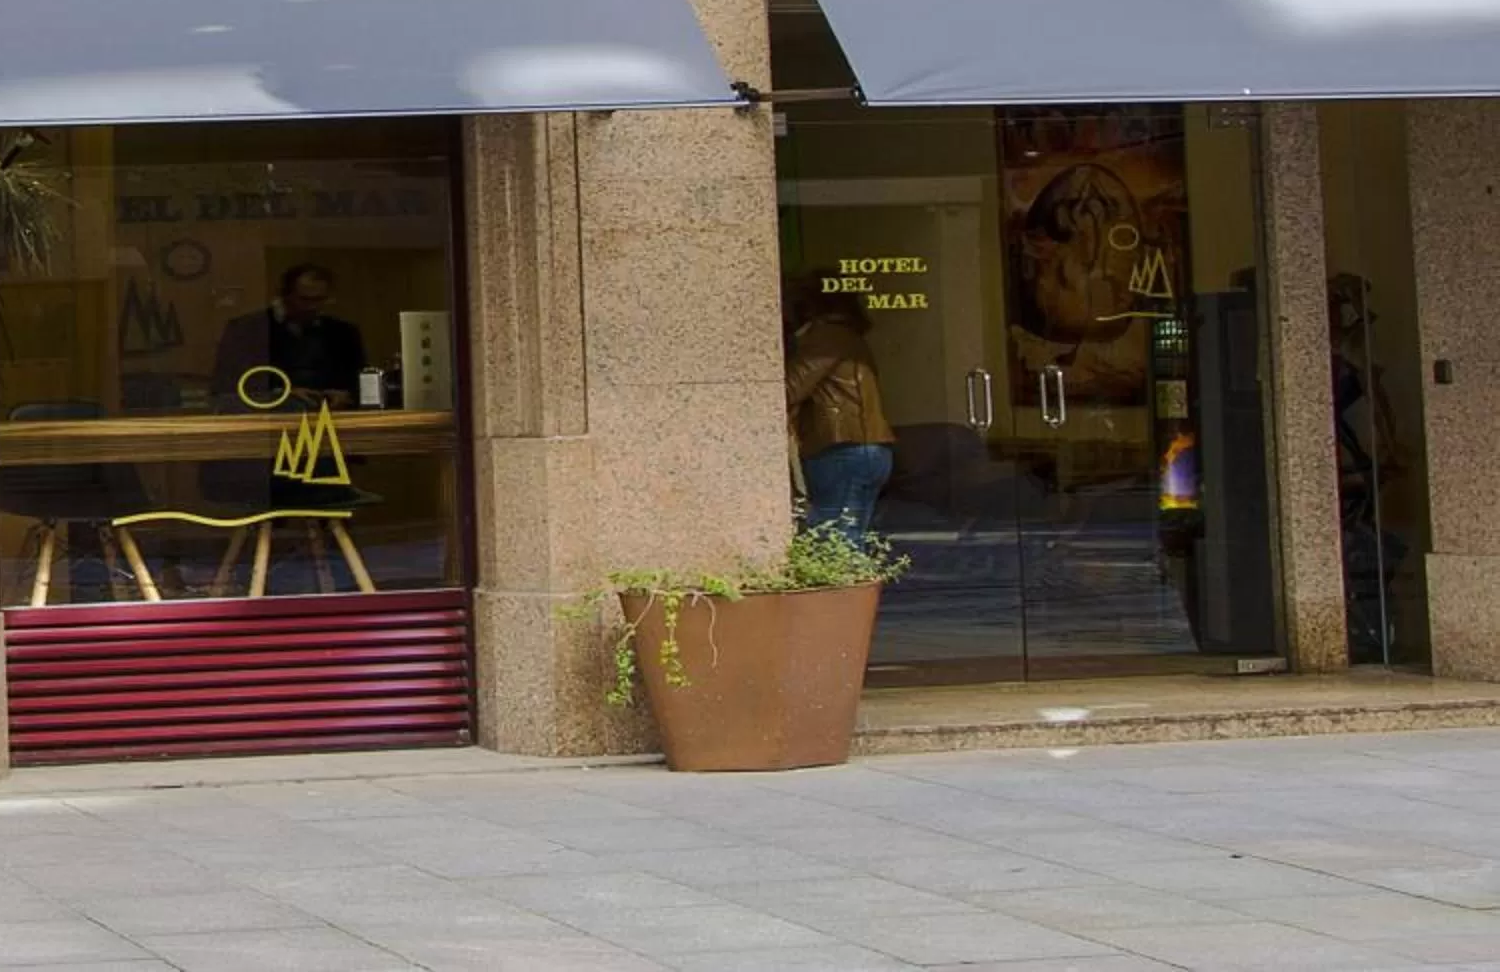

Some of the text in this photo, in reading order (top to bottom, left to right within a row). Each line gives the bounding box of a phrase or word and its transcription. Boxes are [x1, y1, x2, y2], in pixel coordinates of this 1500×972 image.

[839, 257, 927, 274] HOTEL
[821, 277, 873, 293] DEL
[867, 293, 928, 309] MAR
